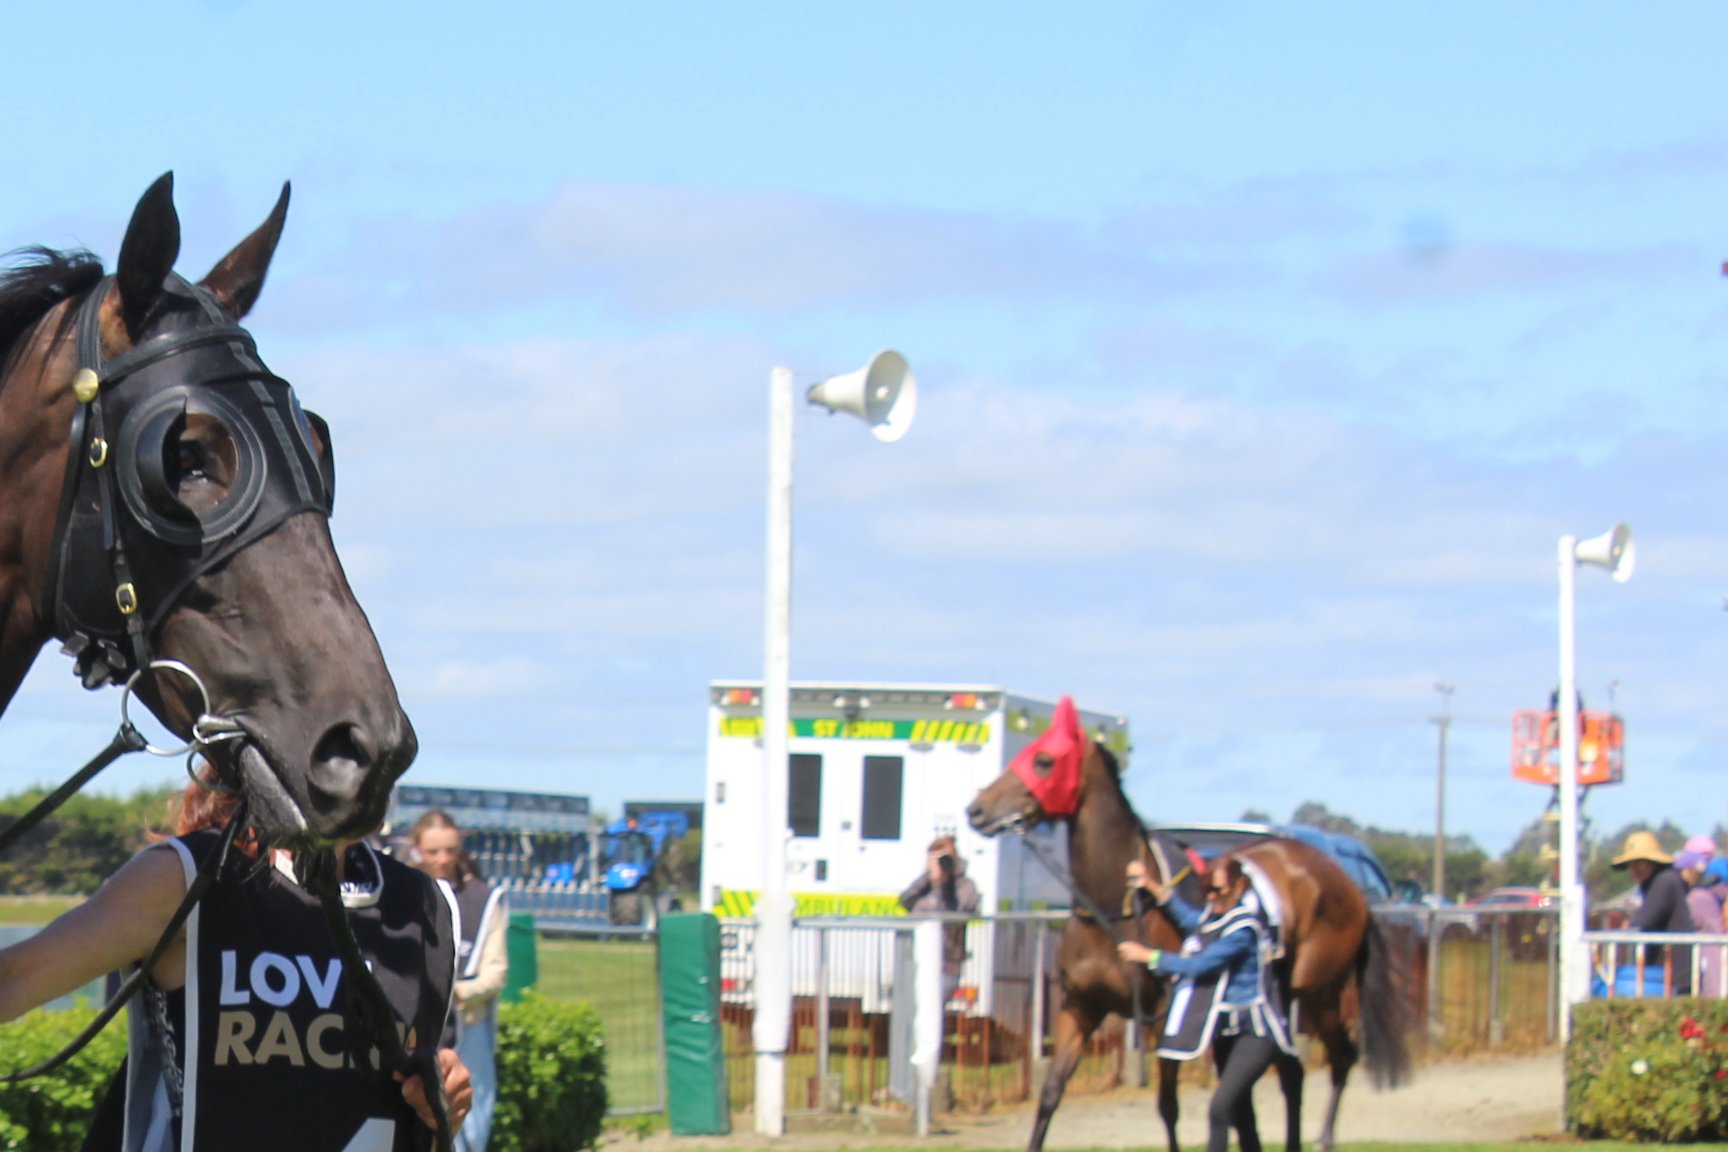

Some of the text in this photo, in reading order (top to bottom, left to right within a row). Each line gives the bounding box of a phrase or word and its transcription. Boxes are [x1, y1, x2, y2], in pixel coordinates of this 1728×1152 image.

[813, 719, 838, 737] ST
[219, 949, 373, 1009] LOV
[214, 1010, 417, 1070] RAC
